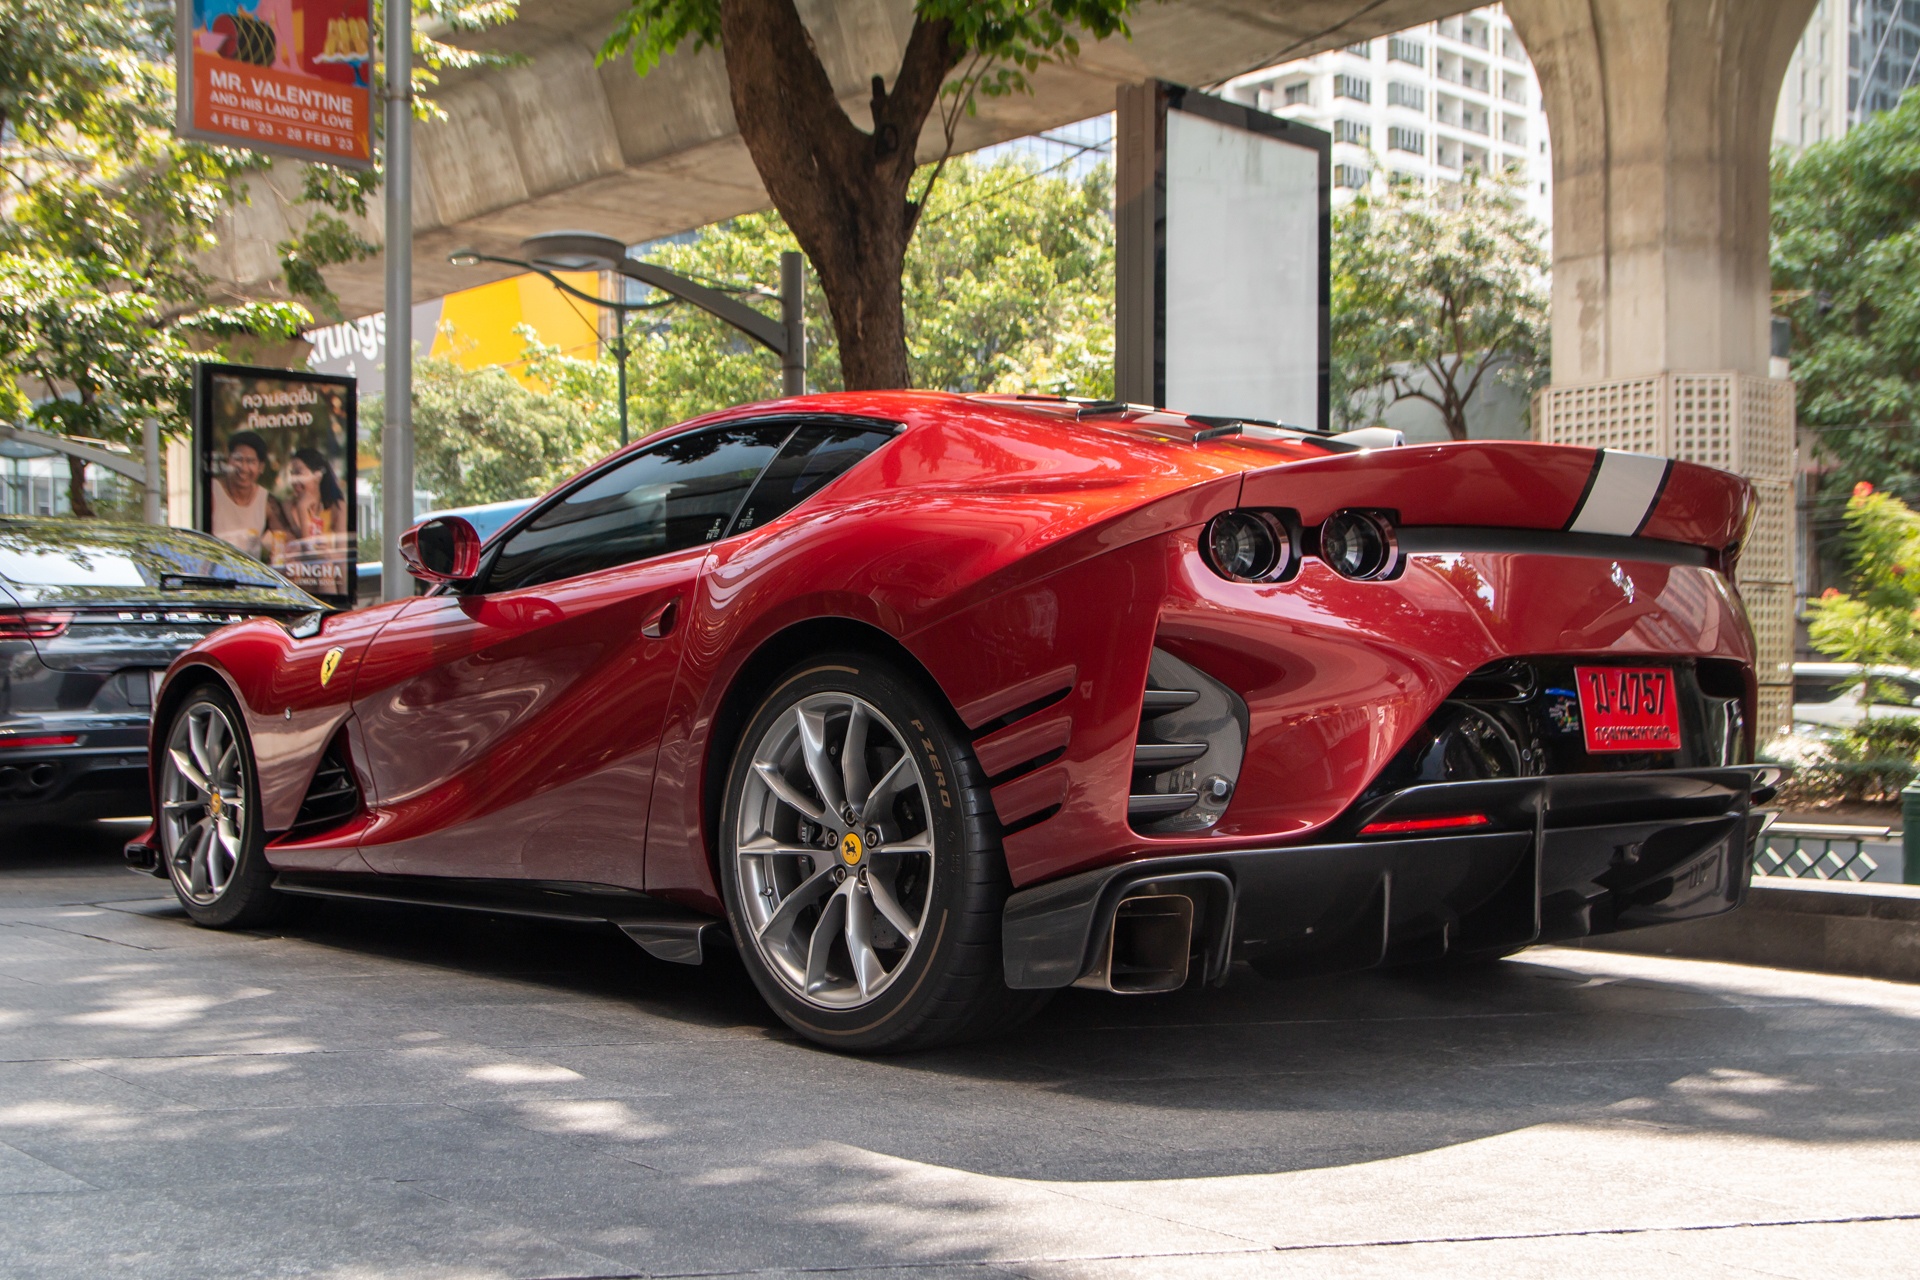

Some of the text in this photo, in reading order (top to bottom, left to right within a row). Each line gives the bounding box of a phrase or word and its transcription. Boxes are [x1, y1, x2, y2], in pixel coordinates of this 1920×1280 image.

[210, 68, 353, 115] MR. VALENTINE
[210, 90, 353, 131] AND HIS LAND OF LOVE
[223, 115, 249, 131] FEB
[306, 130, 331, 147] FEB
[242, 385, 318, 409] ความสดชื่น
[286, 563, 342, 578] SINGHA
[118, 612, 252, 622] PORSCH
